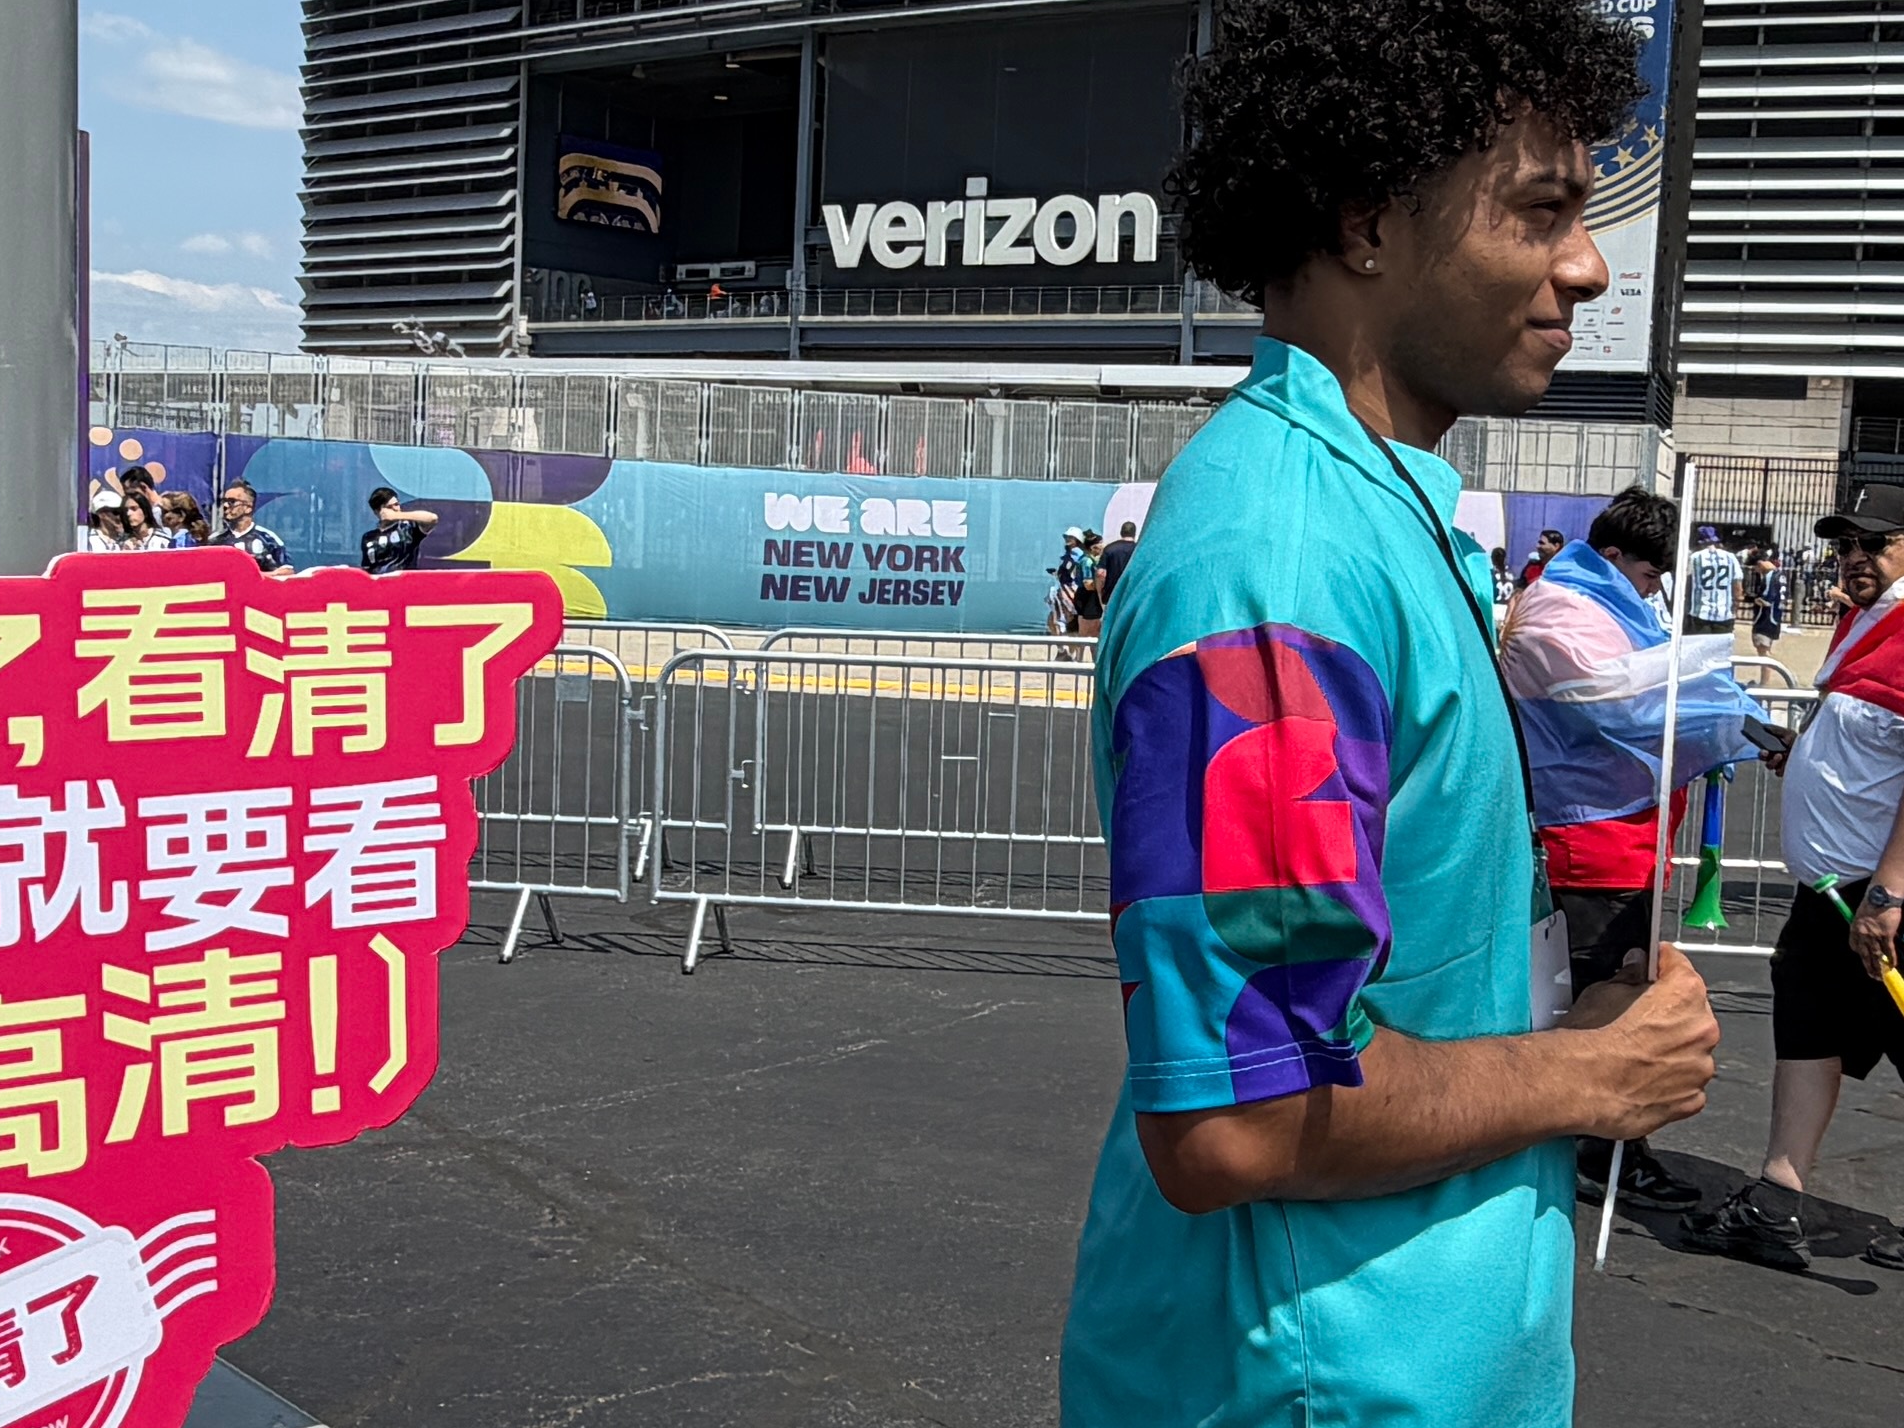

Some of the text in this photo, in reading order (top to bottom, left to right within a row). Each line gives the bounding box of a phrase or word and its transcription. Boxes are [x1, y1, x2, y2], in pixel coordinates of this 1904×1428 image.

[821, 176, 1159, 269] verizon
[764, 492, 850, 534] WE
[763, 539, 966, 573] NEW YORK
[760, 573, 965, 606] NEW JERSEY
[1701, 565, 1729, 590] 22
